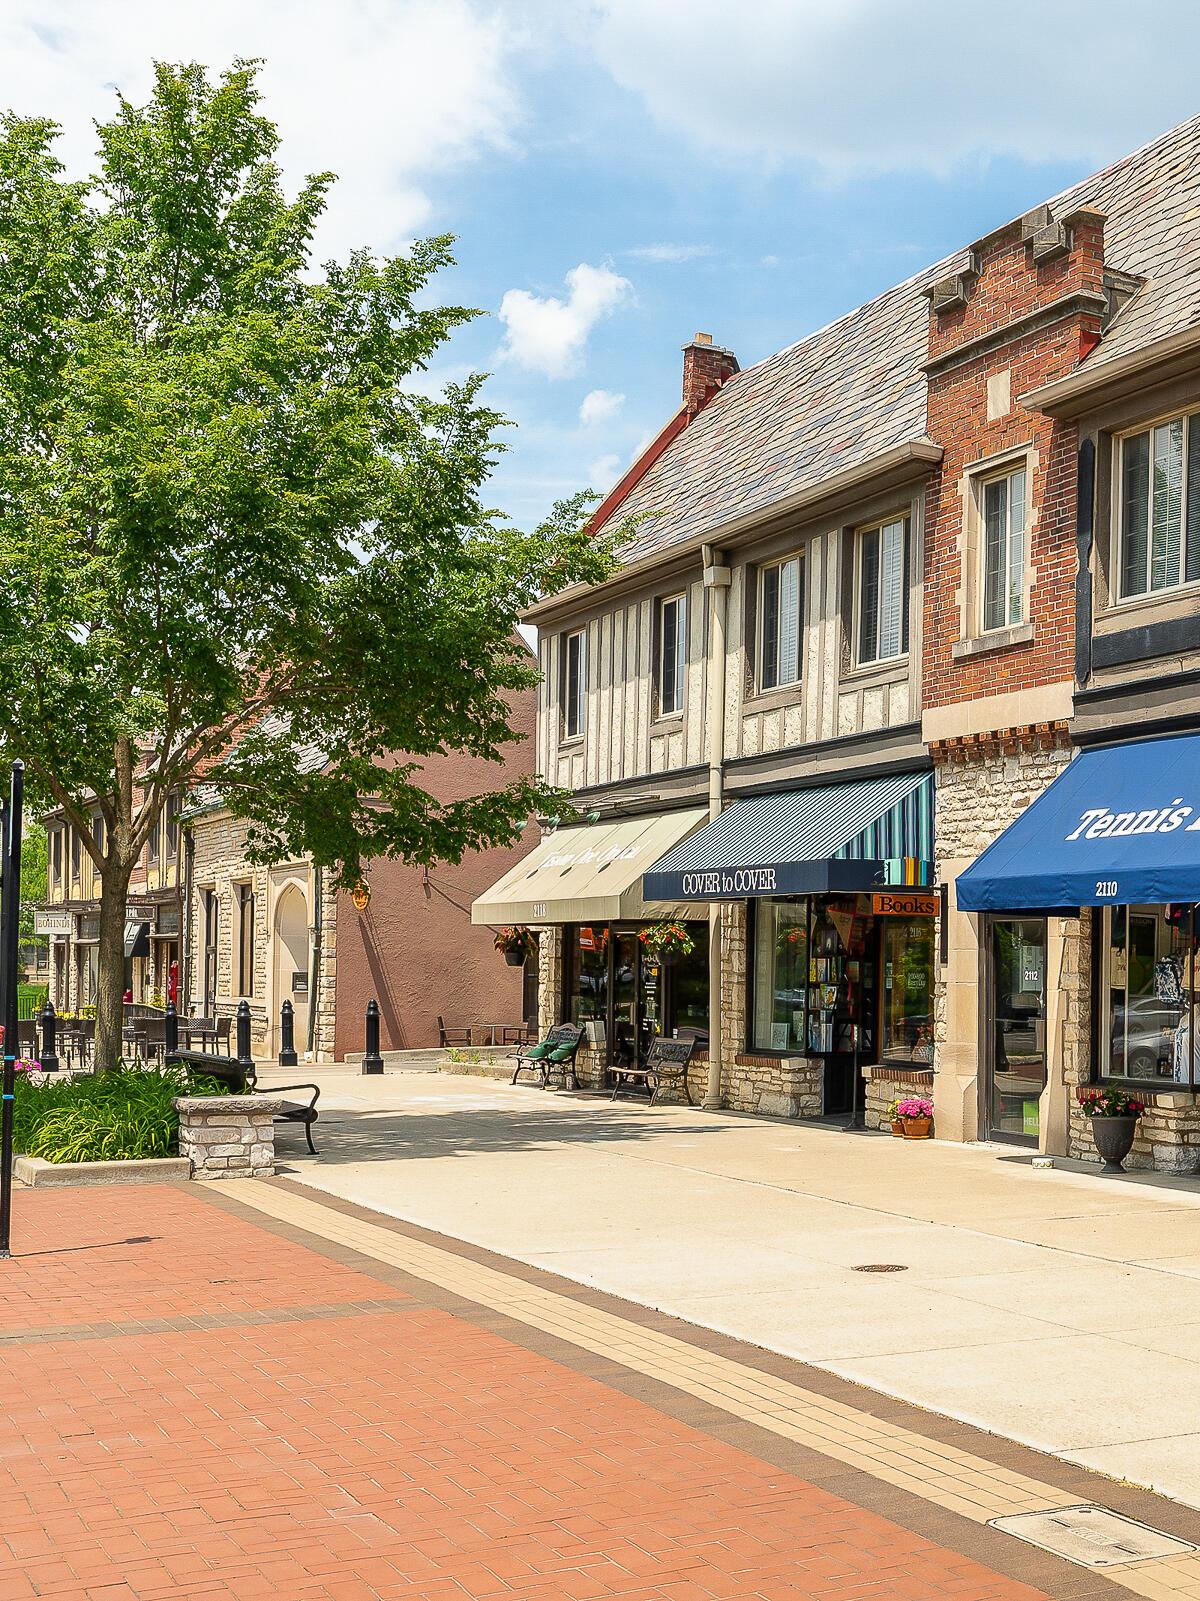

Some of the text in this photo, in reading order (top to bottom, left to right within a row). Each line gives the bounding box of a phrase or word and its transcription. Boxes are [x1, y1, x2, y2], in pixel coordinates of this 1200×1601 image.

[1064, 797, 1193, 841] Tennis
[682, 868, 777, 895] COVER to COVER
[1095, 881, 1118, 897] 2110
[879, 896, 935, 914] Books
[1024, 970, 1038, 981] 2112
